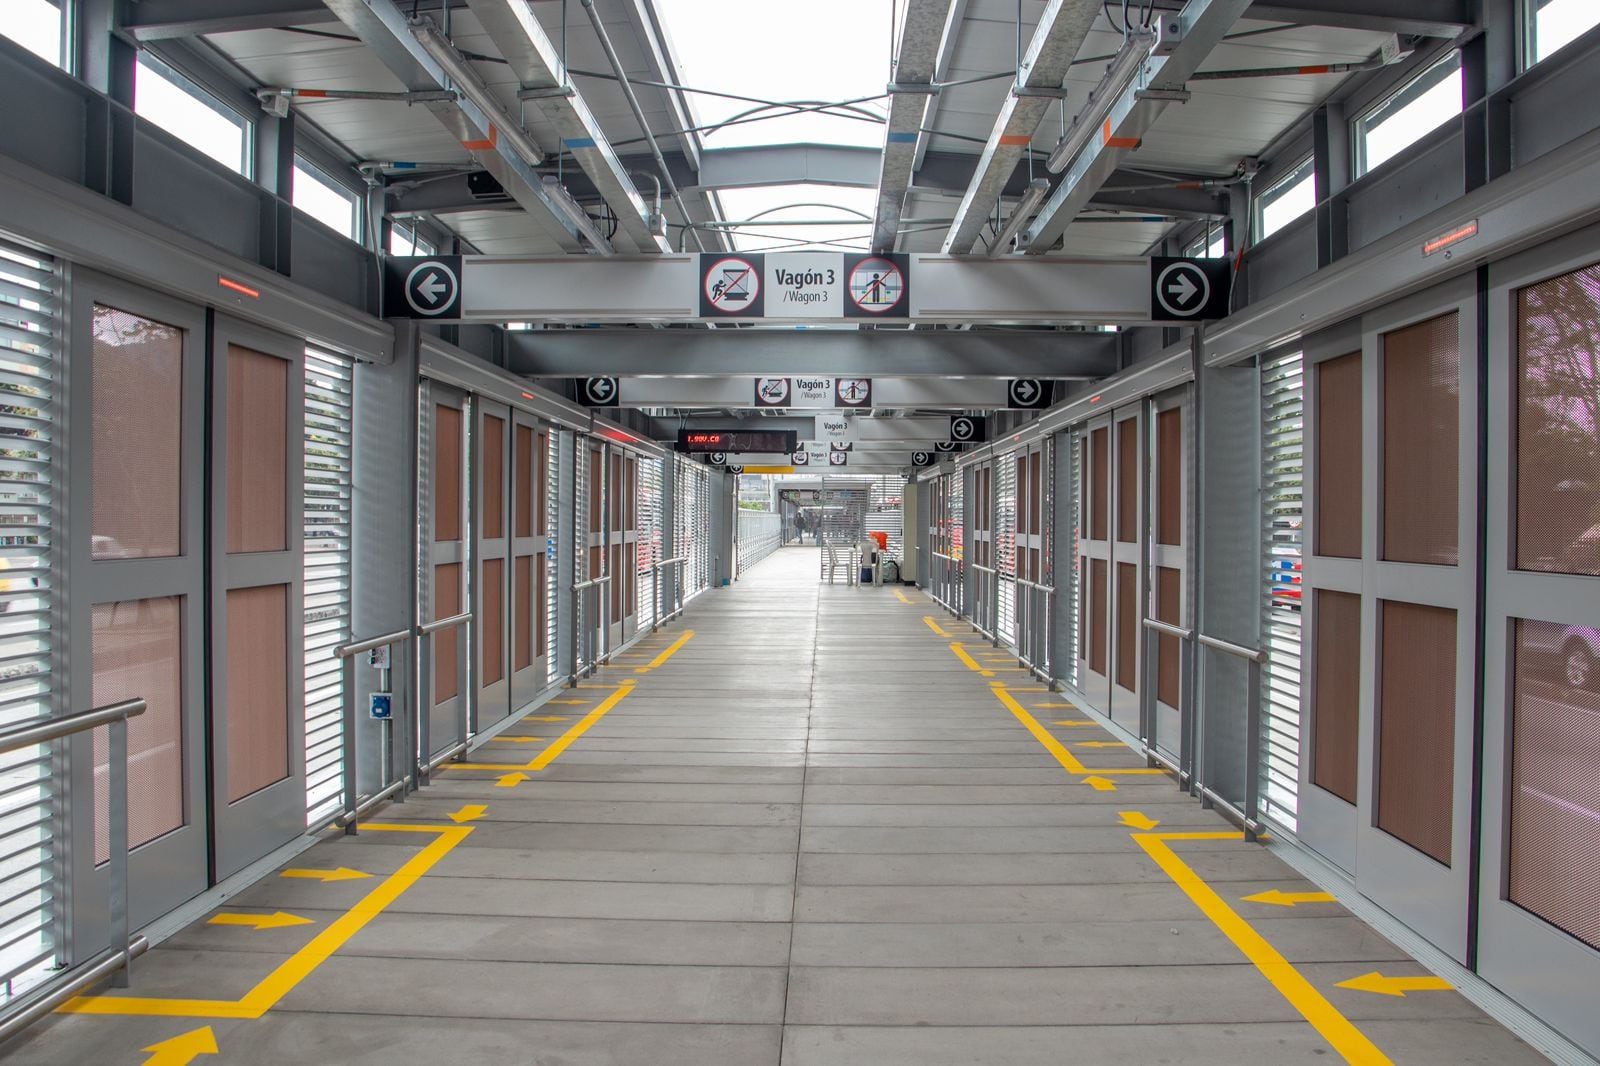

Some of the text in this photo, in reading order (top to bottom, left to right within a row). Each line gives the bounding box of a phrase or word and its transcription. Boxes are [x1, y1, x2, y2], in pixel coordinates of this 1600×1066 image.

[775, 268, 835, 289] Vagón 3
[822, 290, 828, 302] 3
[797, 379, 830, 391] Vagón 3
[824, 421, 847, 431] Vagón 3
